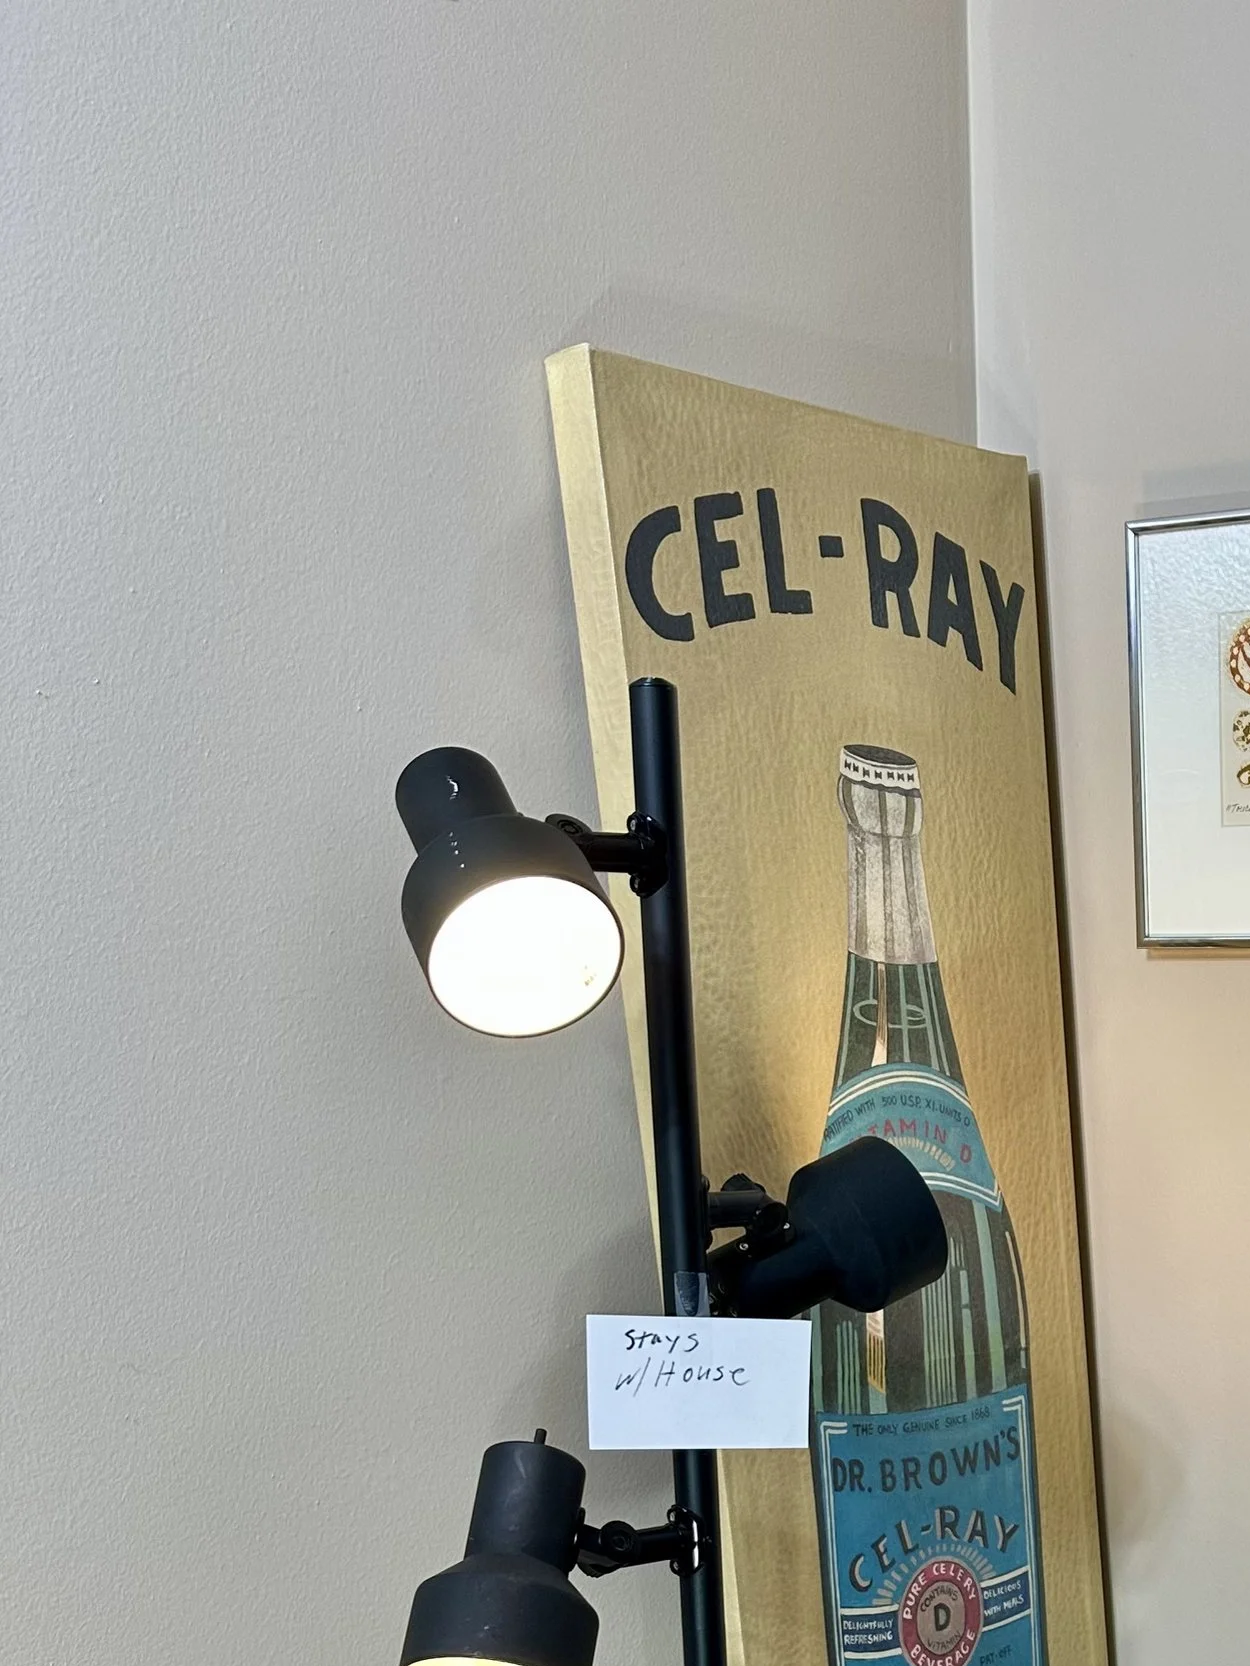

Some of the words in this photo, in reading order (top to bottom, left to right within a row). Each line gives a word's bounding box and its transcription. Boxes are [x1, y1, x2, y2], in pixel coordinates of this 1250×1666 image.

[625, 487, 1025, 695] CEL-RAY
[854, 1100, 876, 1116] WITH
[882, 1094, 898, 1107] 500
[853, 1423, 873, 1437] THE
[877, 1423, 899, 1436] ONLY
[902, 1418, 941, 1434] GENUINE
[945, 1414, 968, 1428] SINCE
[832, 1456, 873, 1493] DR.
[879, 1426, 1021, 1493] BROWN'S
[849, 1504, 1020, 1592] CEL-RAY
[902, 1574, 928, 1620] PURE
[931, 1562, 977, 1600] CELERY
[934, 1602, 951, 1632] D
